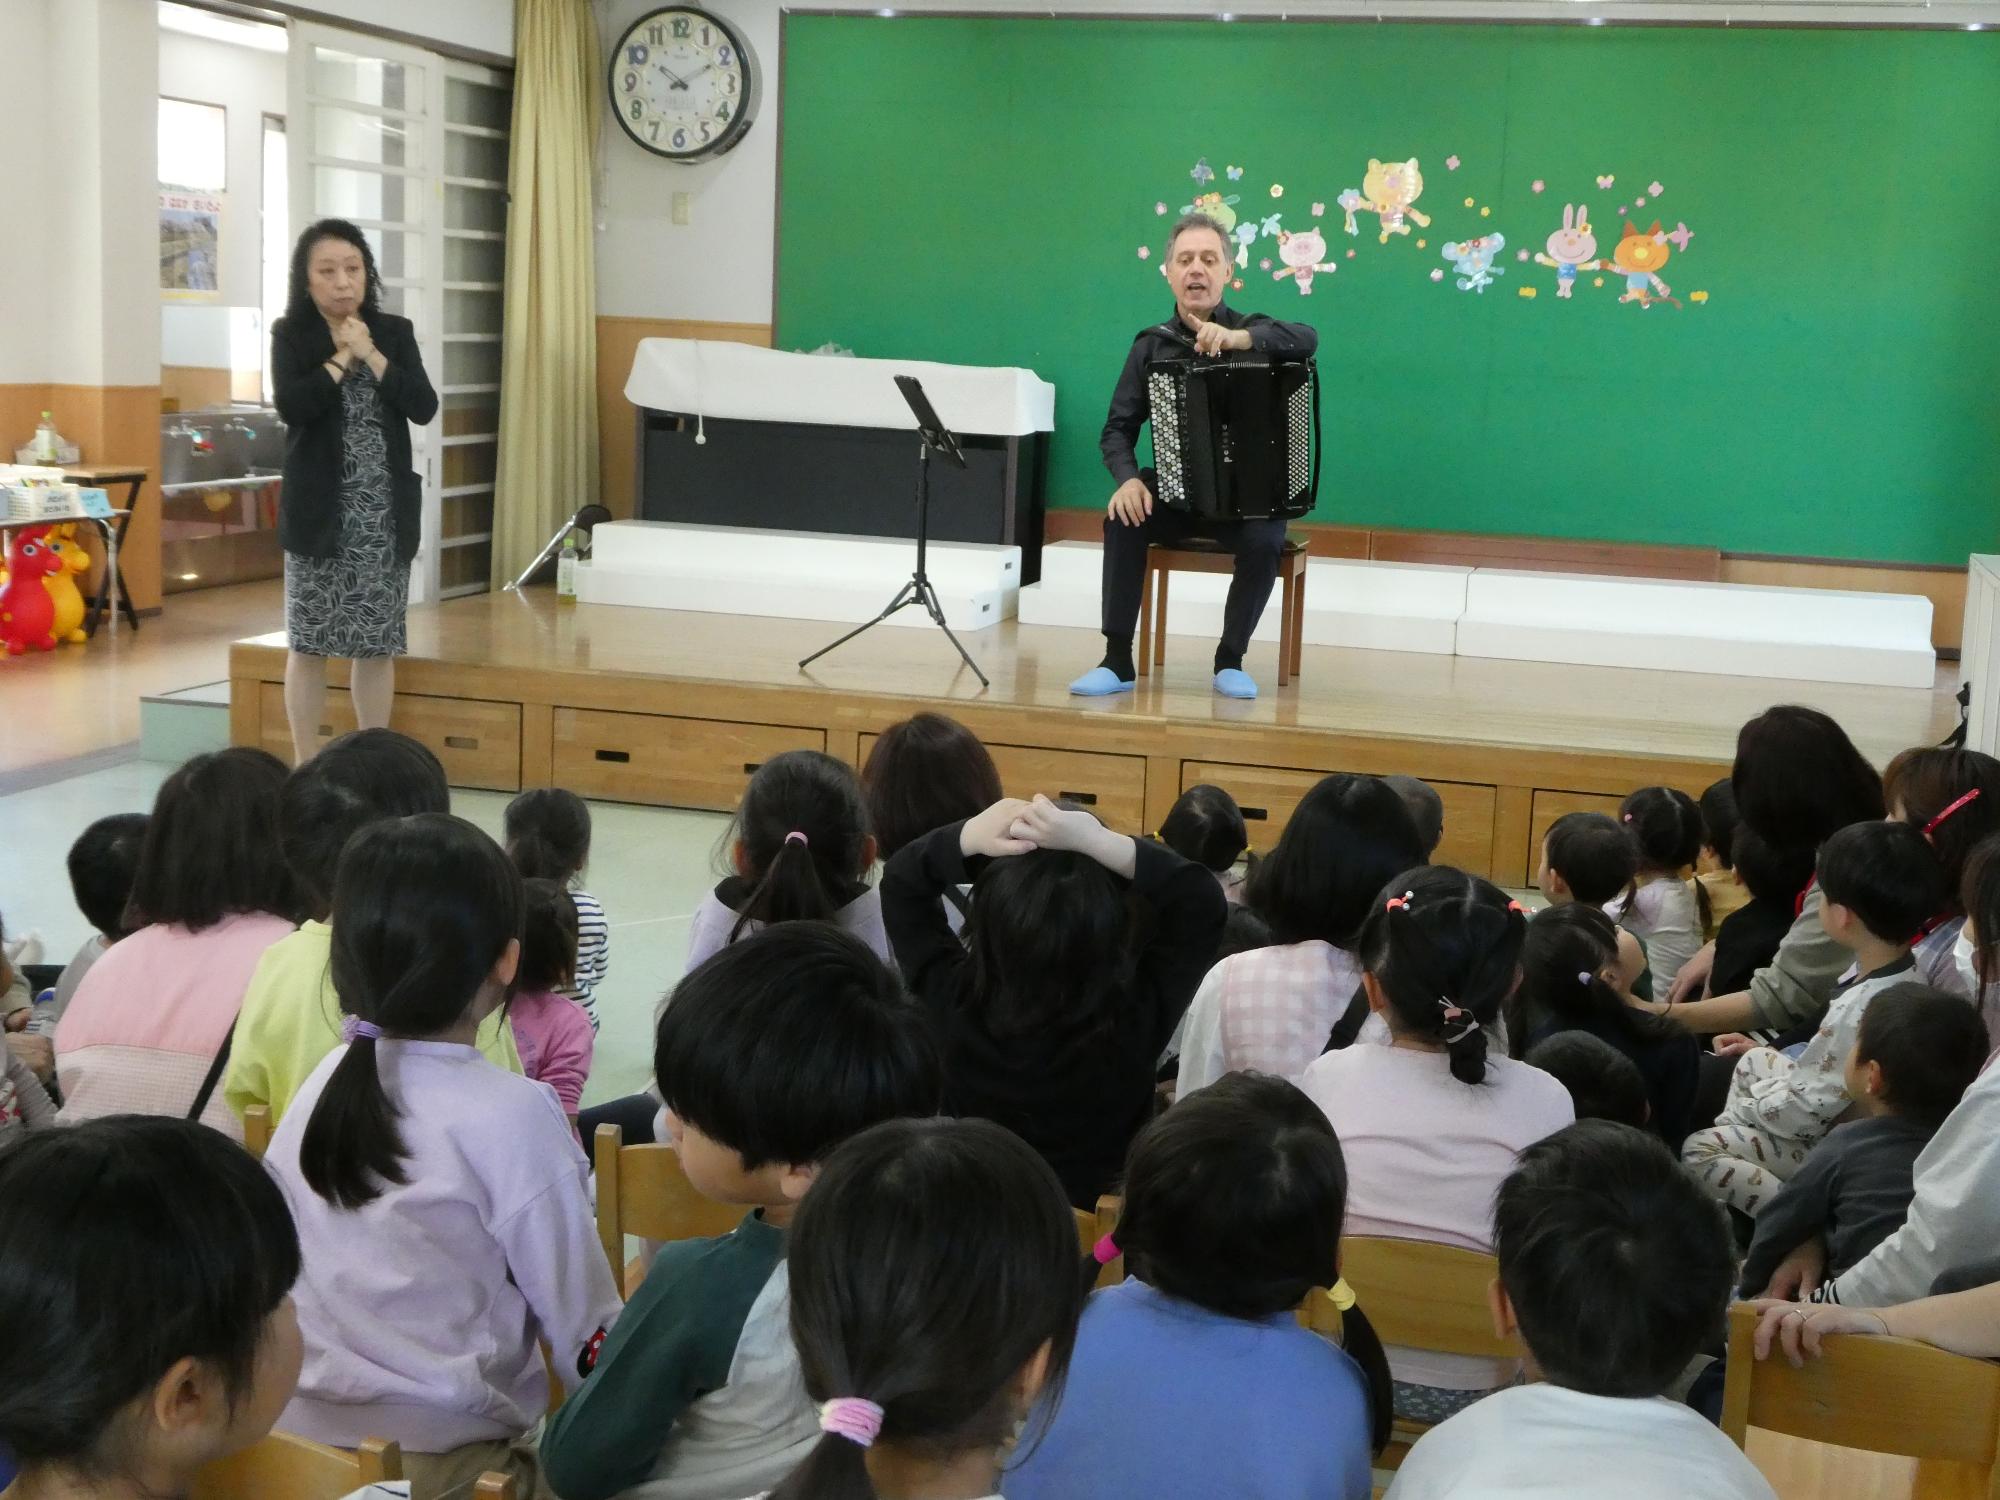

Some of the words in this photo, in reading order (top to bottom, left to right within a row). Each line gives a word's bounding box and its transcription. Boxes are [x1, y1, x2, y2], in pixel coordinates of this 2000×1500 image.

[649, 25, 664, 46] 11
[672, 17, 690, 38] 12
[702, 25, 710, 46] 1
[627, 44, 649, 65] 10
[719, 45, 731, 66] 2
[624, 72, 637, 92] 9
[727, 73, 736, 94] 3
[630, 99, 642, 120] 8
[715, 101, 730, 122] 4
[648, 121, 660, 141] 7
[672, 128, 686, 148] 6
[700, 121, 710, 142] 5
